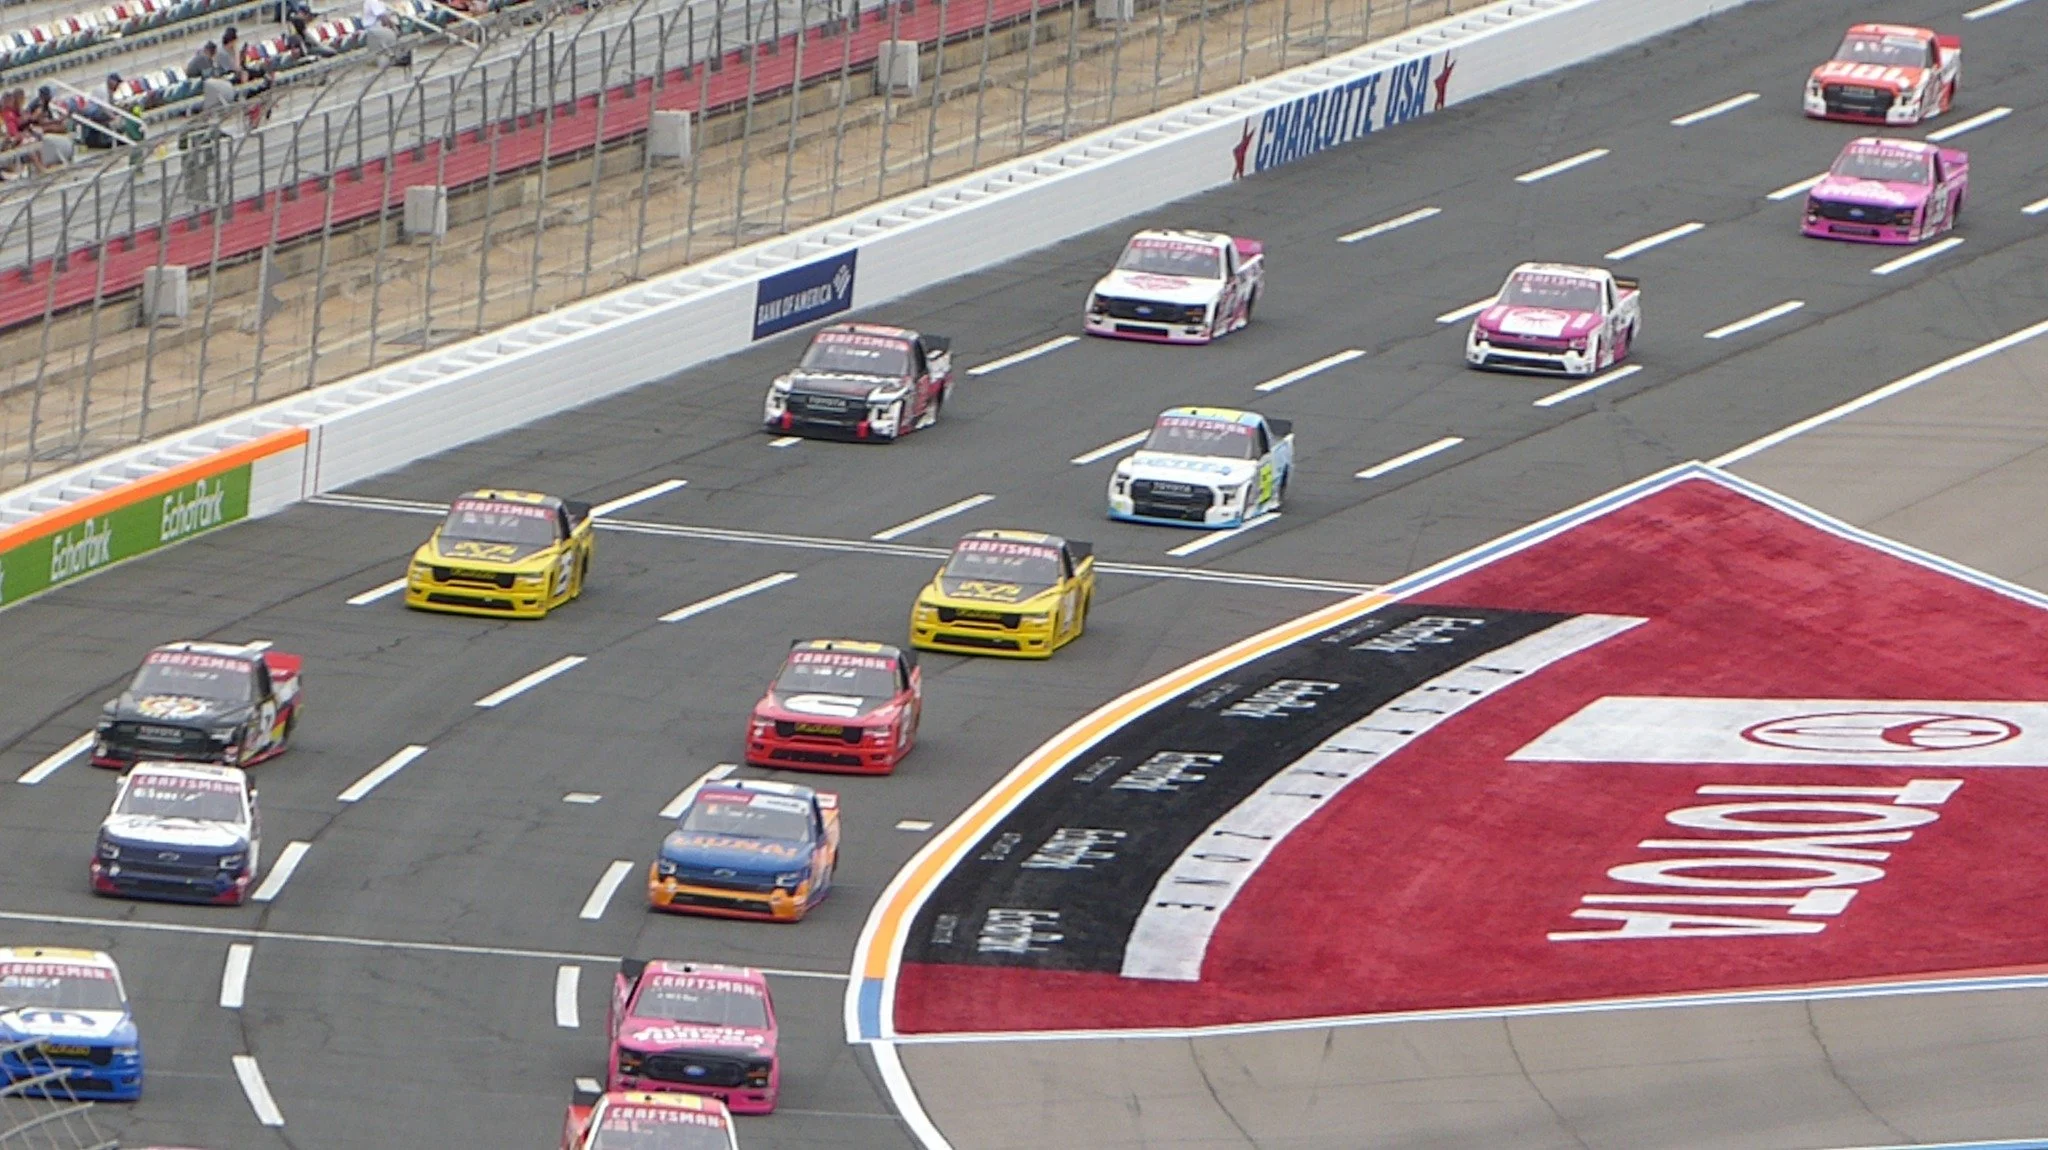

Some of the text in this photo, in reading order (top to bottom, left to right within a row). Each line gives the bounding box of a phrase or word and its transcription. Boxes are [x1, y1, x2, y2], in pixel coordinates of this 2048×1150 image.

[1255, 55, 1432, 172] CHARLOTTE USA
[757, 283, 832, 325] BANK OF AMERICA
[160, 479, 225, 541] EchoPark
[50, 518, 112, 582] EchoPark
[958, 541, 1052, 559] CRAFTSMAN
[793, 653, 887, 669] CRAFTSMAN
[1157, 829, 1272, 911] ZONE
[1546, 778, 1964, 942] TOYOTA
[1, 965, 106, 979] CRAFTSMAN
[652, 975, 756, 996] CRAFTSMAN
[611, 1107, 720, 1128] CRAFTSMAN
